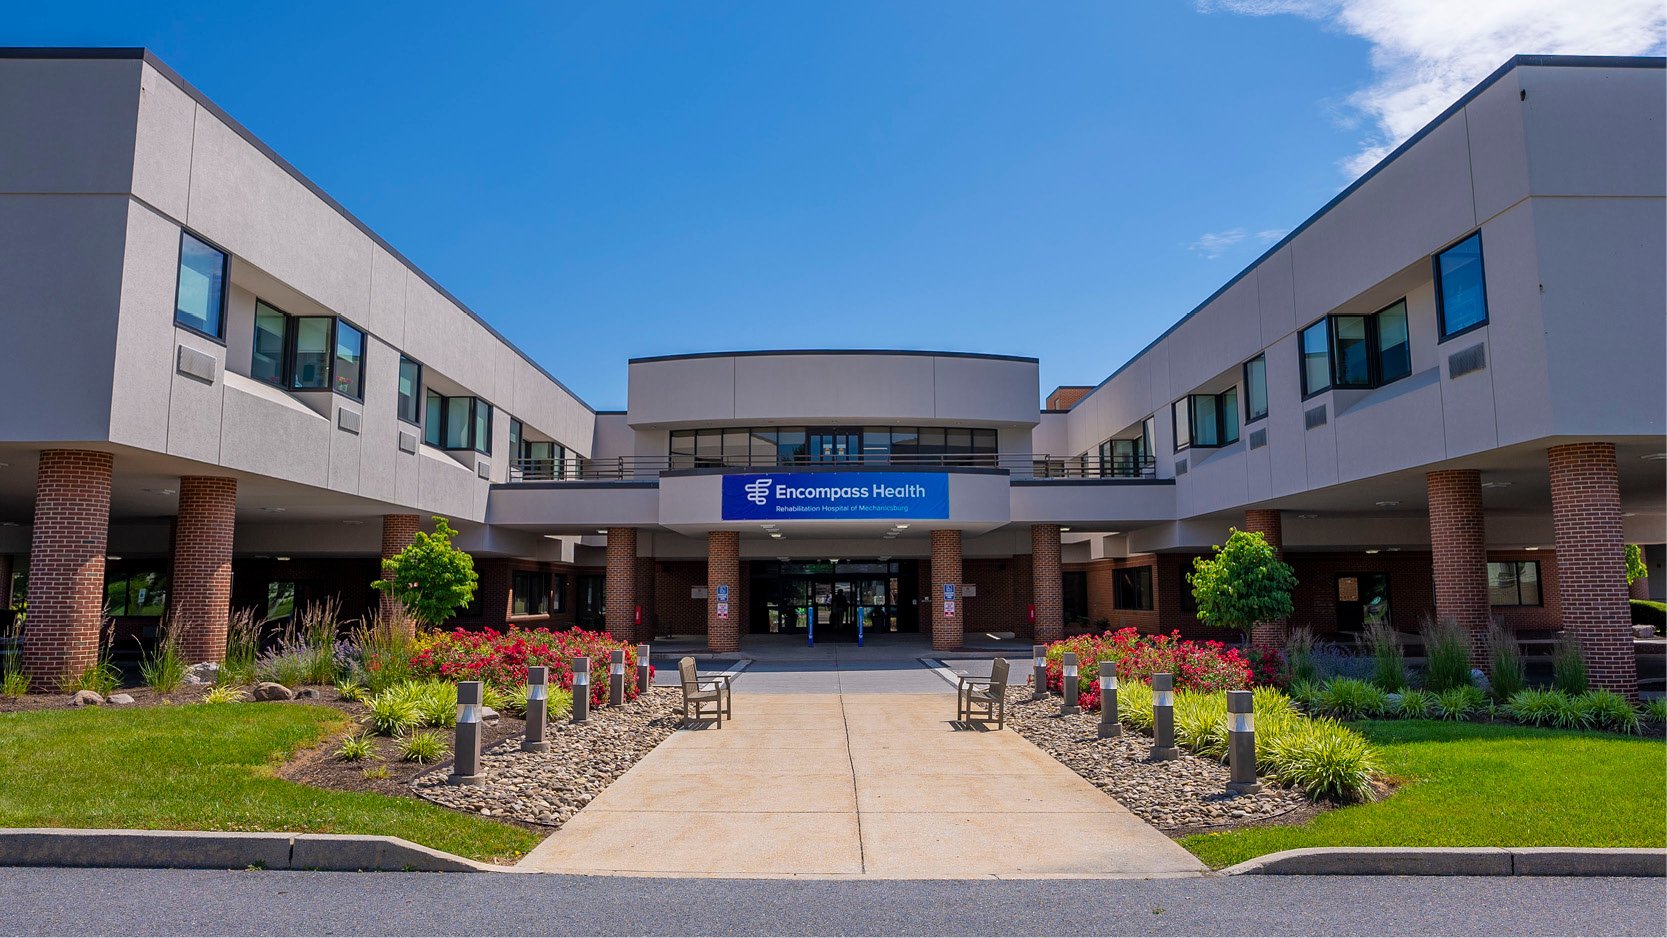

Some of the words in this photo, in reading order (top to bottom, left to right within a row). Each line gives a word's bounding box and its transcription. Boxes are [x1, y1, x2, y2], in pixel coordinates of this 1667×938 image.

[776, 485, 869, 501] Encompass
[873, 484, 925, 498] Health
[822, 505, 849, 513] Hospital
[859, 505, 909, 513] Mechanicsburg
